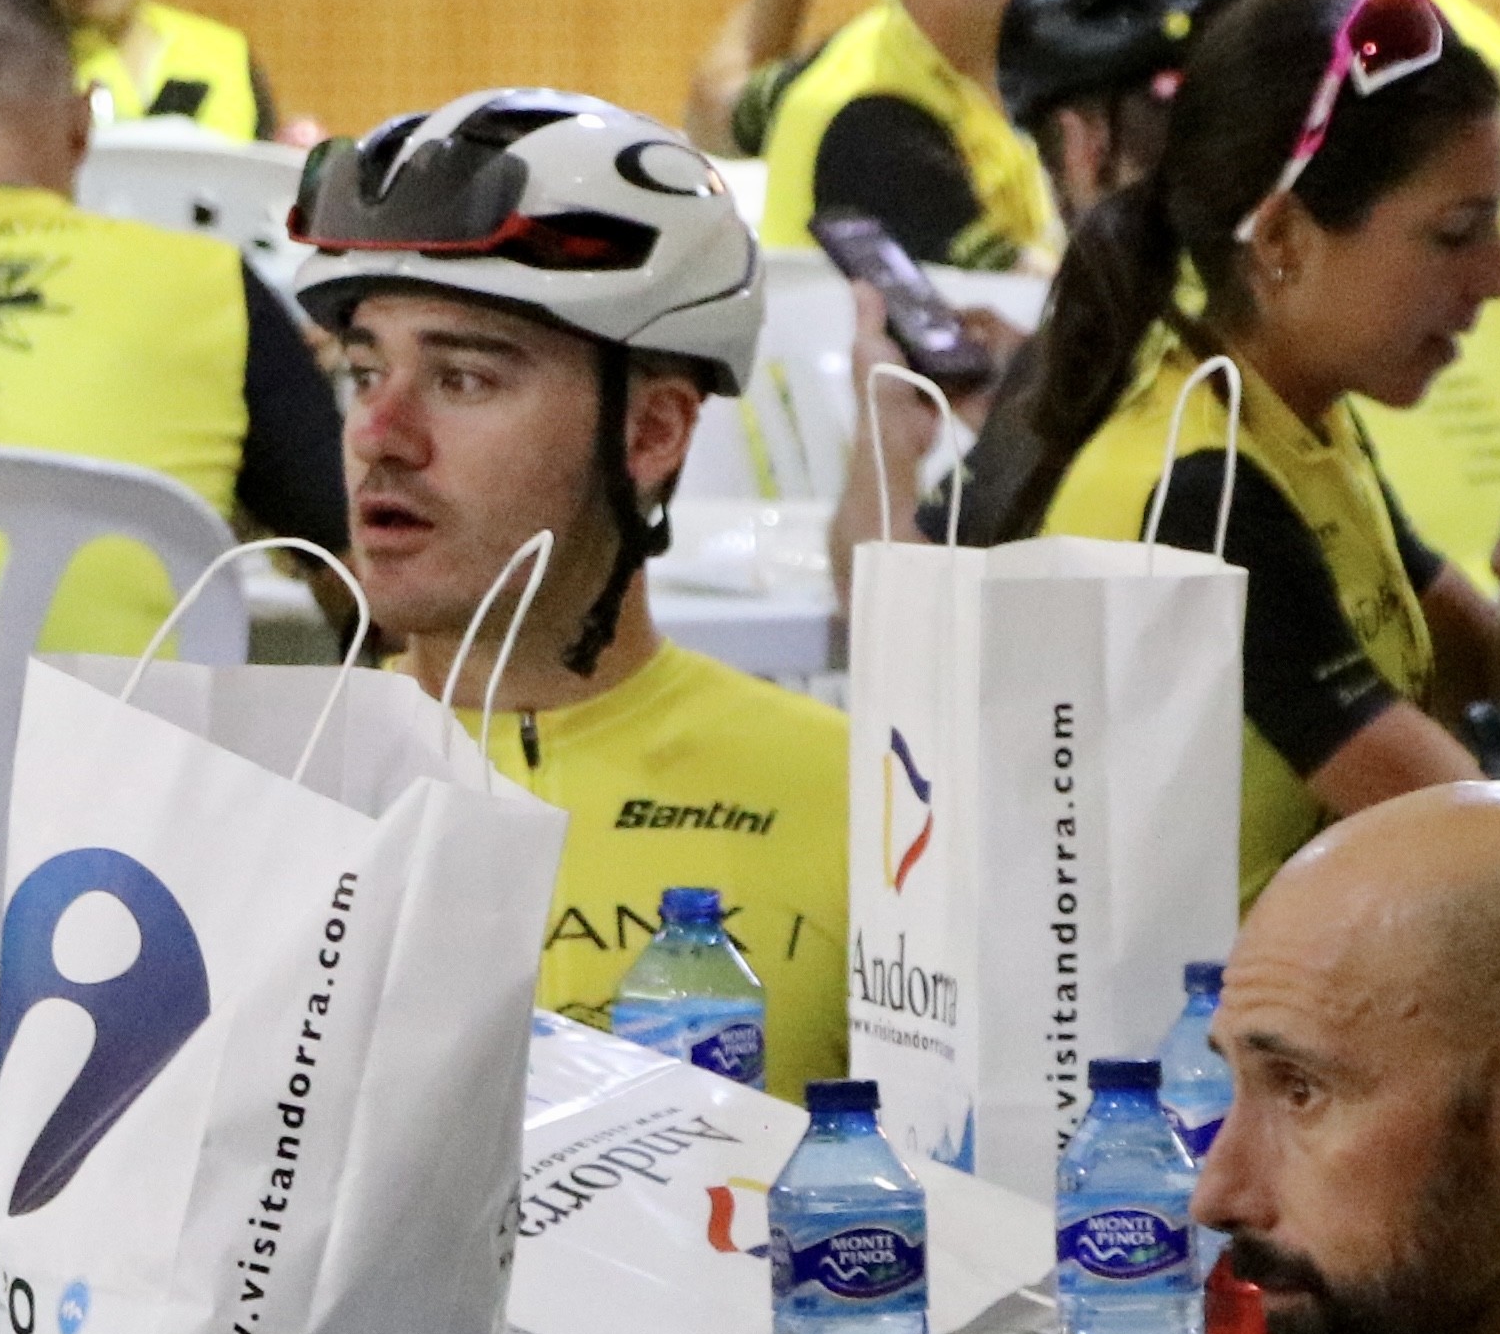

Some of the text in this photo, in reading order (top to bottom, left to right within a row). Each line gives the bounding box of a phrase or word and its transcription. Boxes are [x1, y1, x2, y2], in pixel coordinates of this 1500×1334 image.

[614, 798, 778, 835] Santini
[1087, 1214, 1155, 1234] MONTE
[830, 1234, 895, 1253] MONTE
[1096, 1229, 1156, 1247] PINOS
[837, 1249, 897, 1267] PINOS
